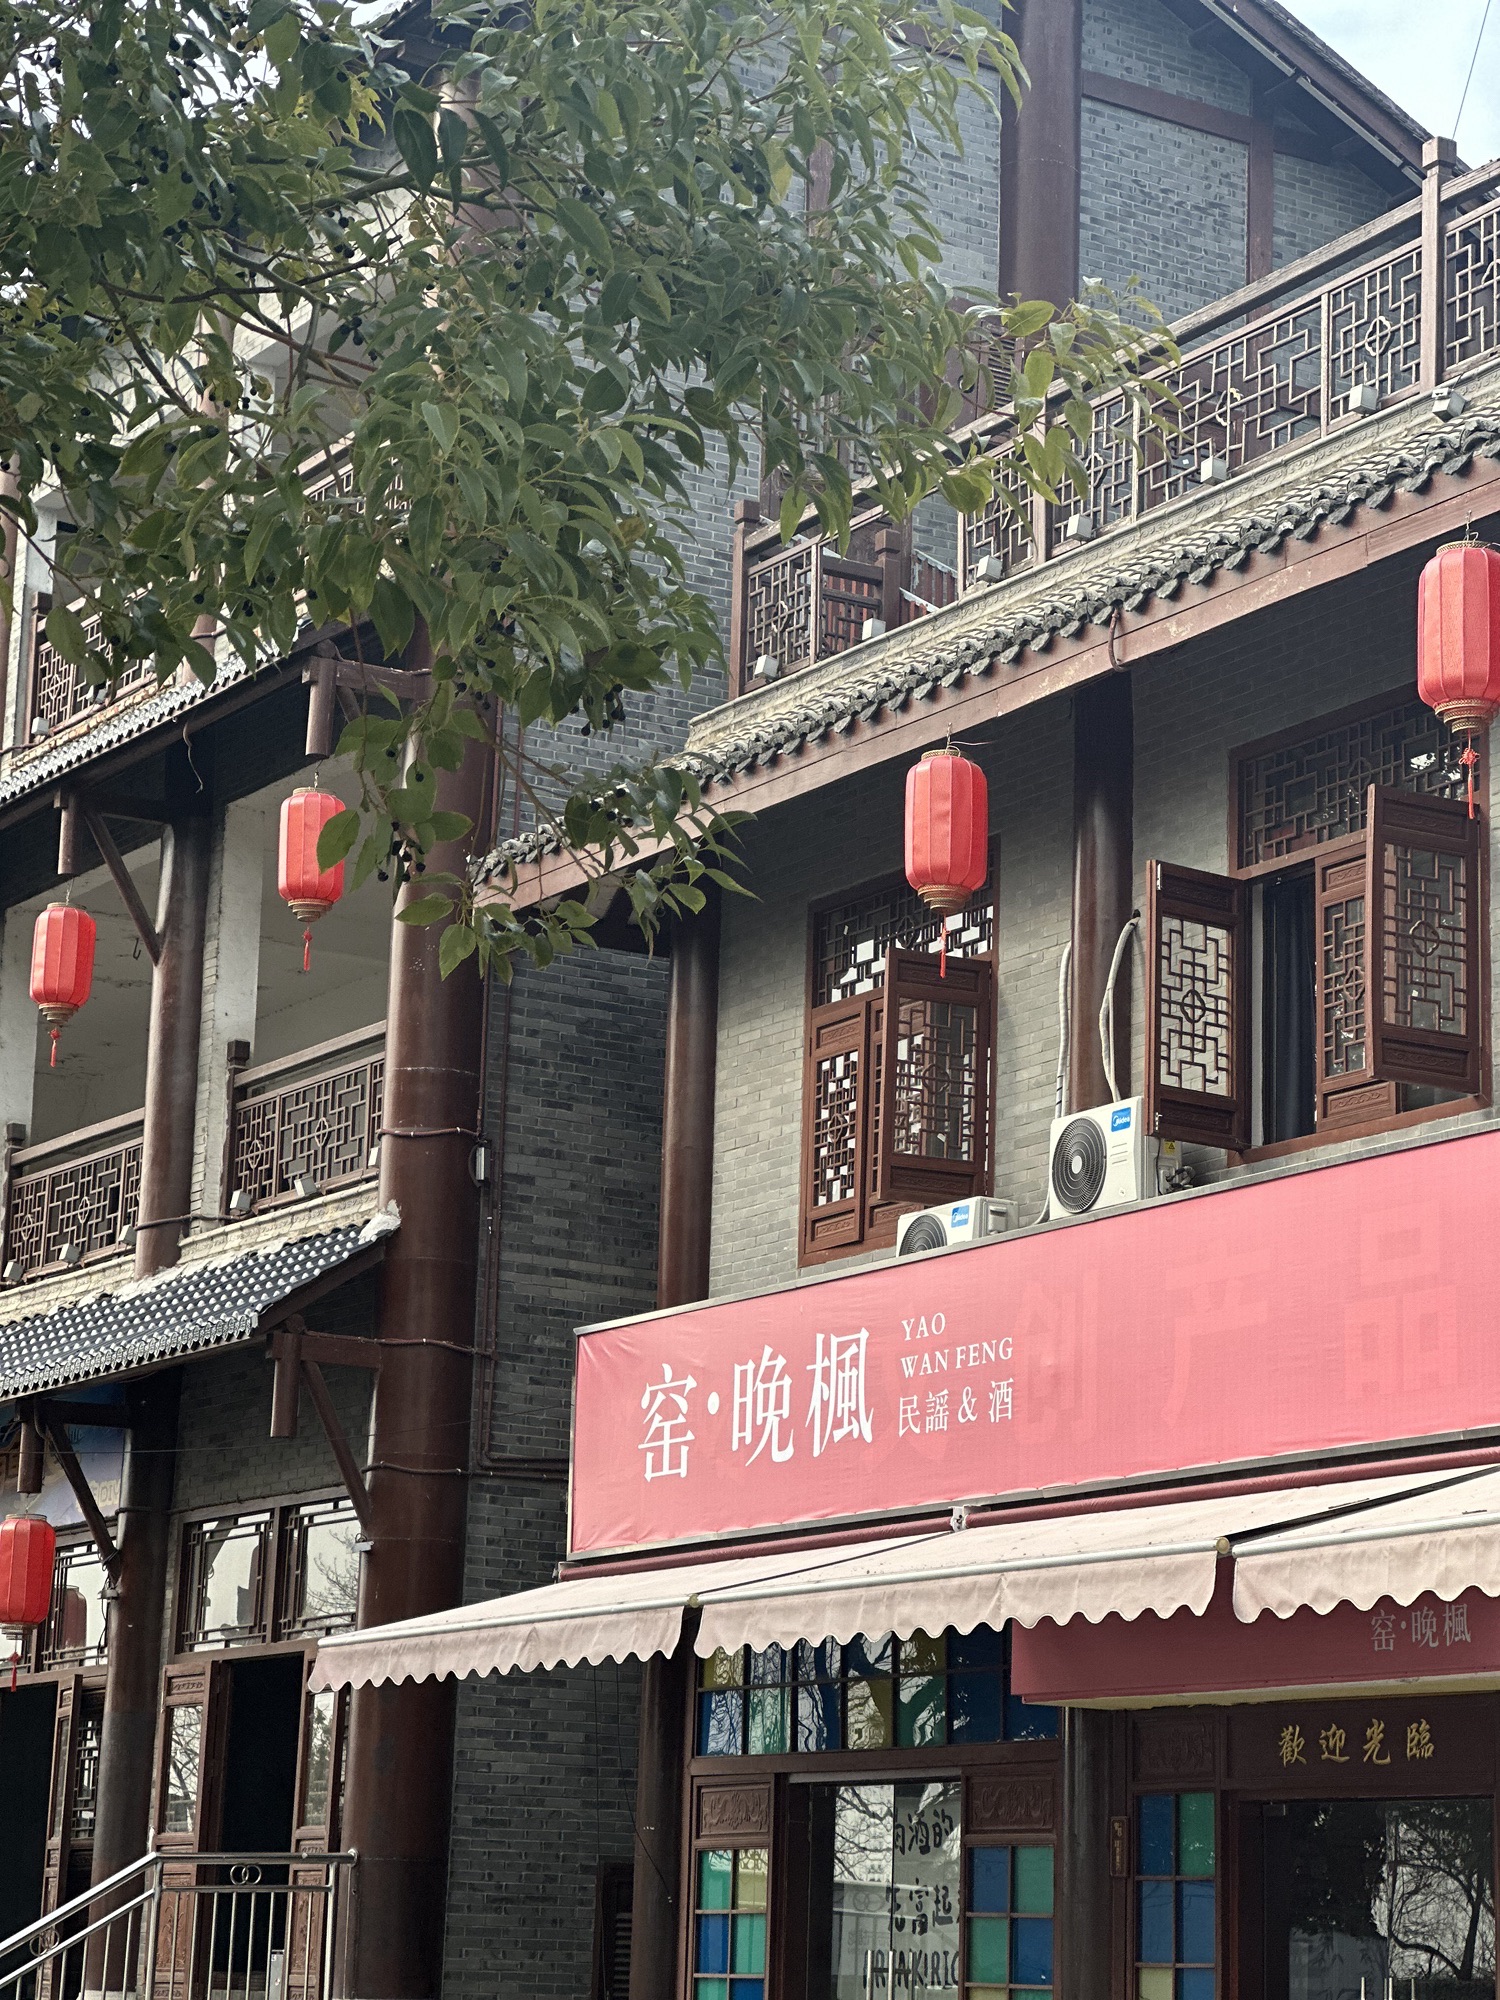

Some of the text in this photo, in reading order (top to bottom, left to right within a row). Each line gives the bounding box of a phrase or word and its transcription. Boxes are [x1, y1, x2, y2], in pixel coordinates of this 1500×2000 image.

[900, 1311, 946, 1341] YAO
[900, 1336, 1013, 1379] WAN FENG
[957, 1385, 978, 1424] &
[988, 1377, 1014, 1423] 酒
[1278, 1717, 1435, 1768] 歡迎光臨
